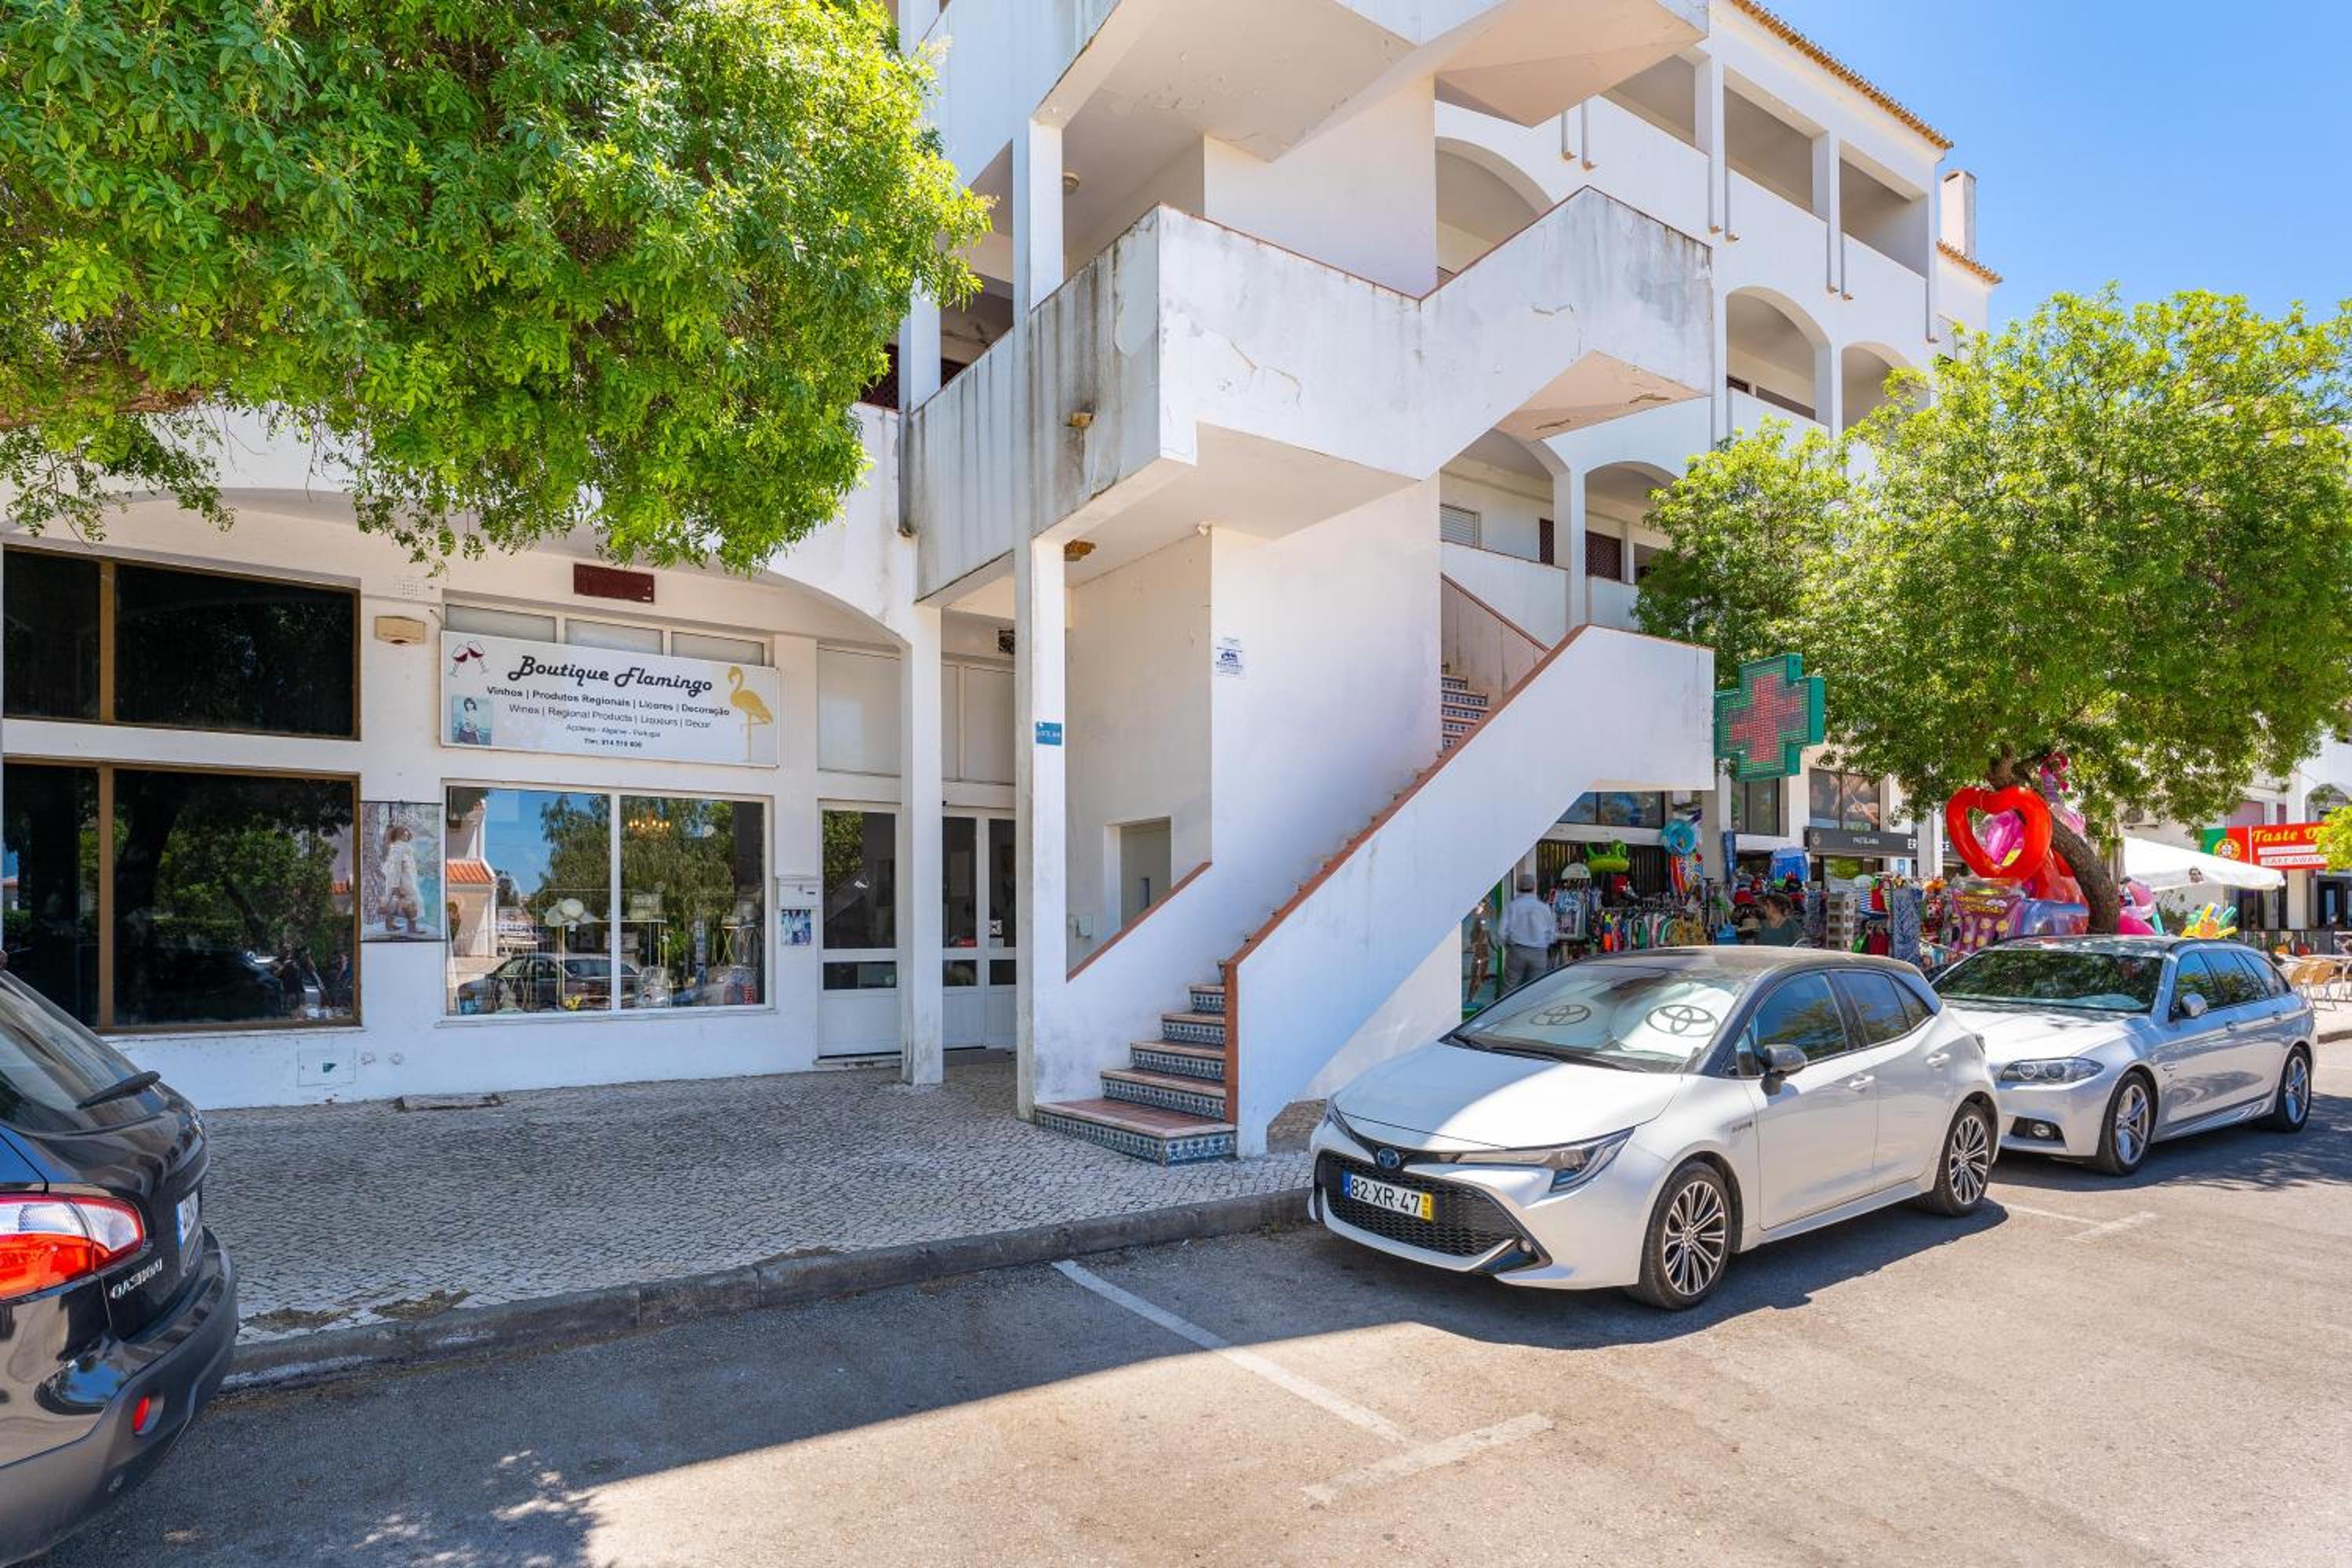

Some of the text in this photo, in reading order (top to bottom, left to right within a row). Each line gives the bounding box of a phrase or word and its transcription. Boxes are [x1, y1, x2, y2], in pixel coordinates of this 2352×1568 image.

[507, 655, 713, 698] Boutique Flamingo
[487, 686, 730, 717] Vinhos Produtos Regionais Licores Decoração
[509, 704, 540, 715] Wines
[548, 707, 590, 719] Regional
[592, 711, 633, 723] Products
[641, 717, 678, 728] Liqueurs
[633, 729, 661, 739] Portugal
[2252, 829, 2299, 844] Taste
